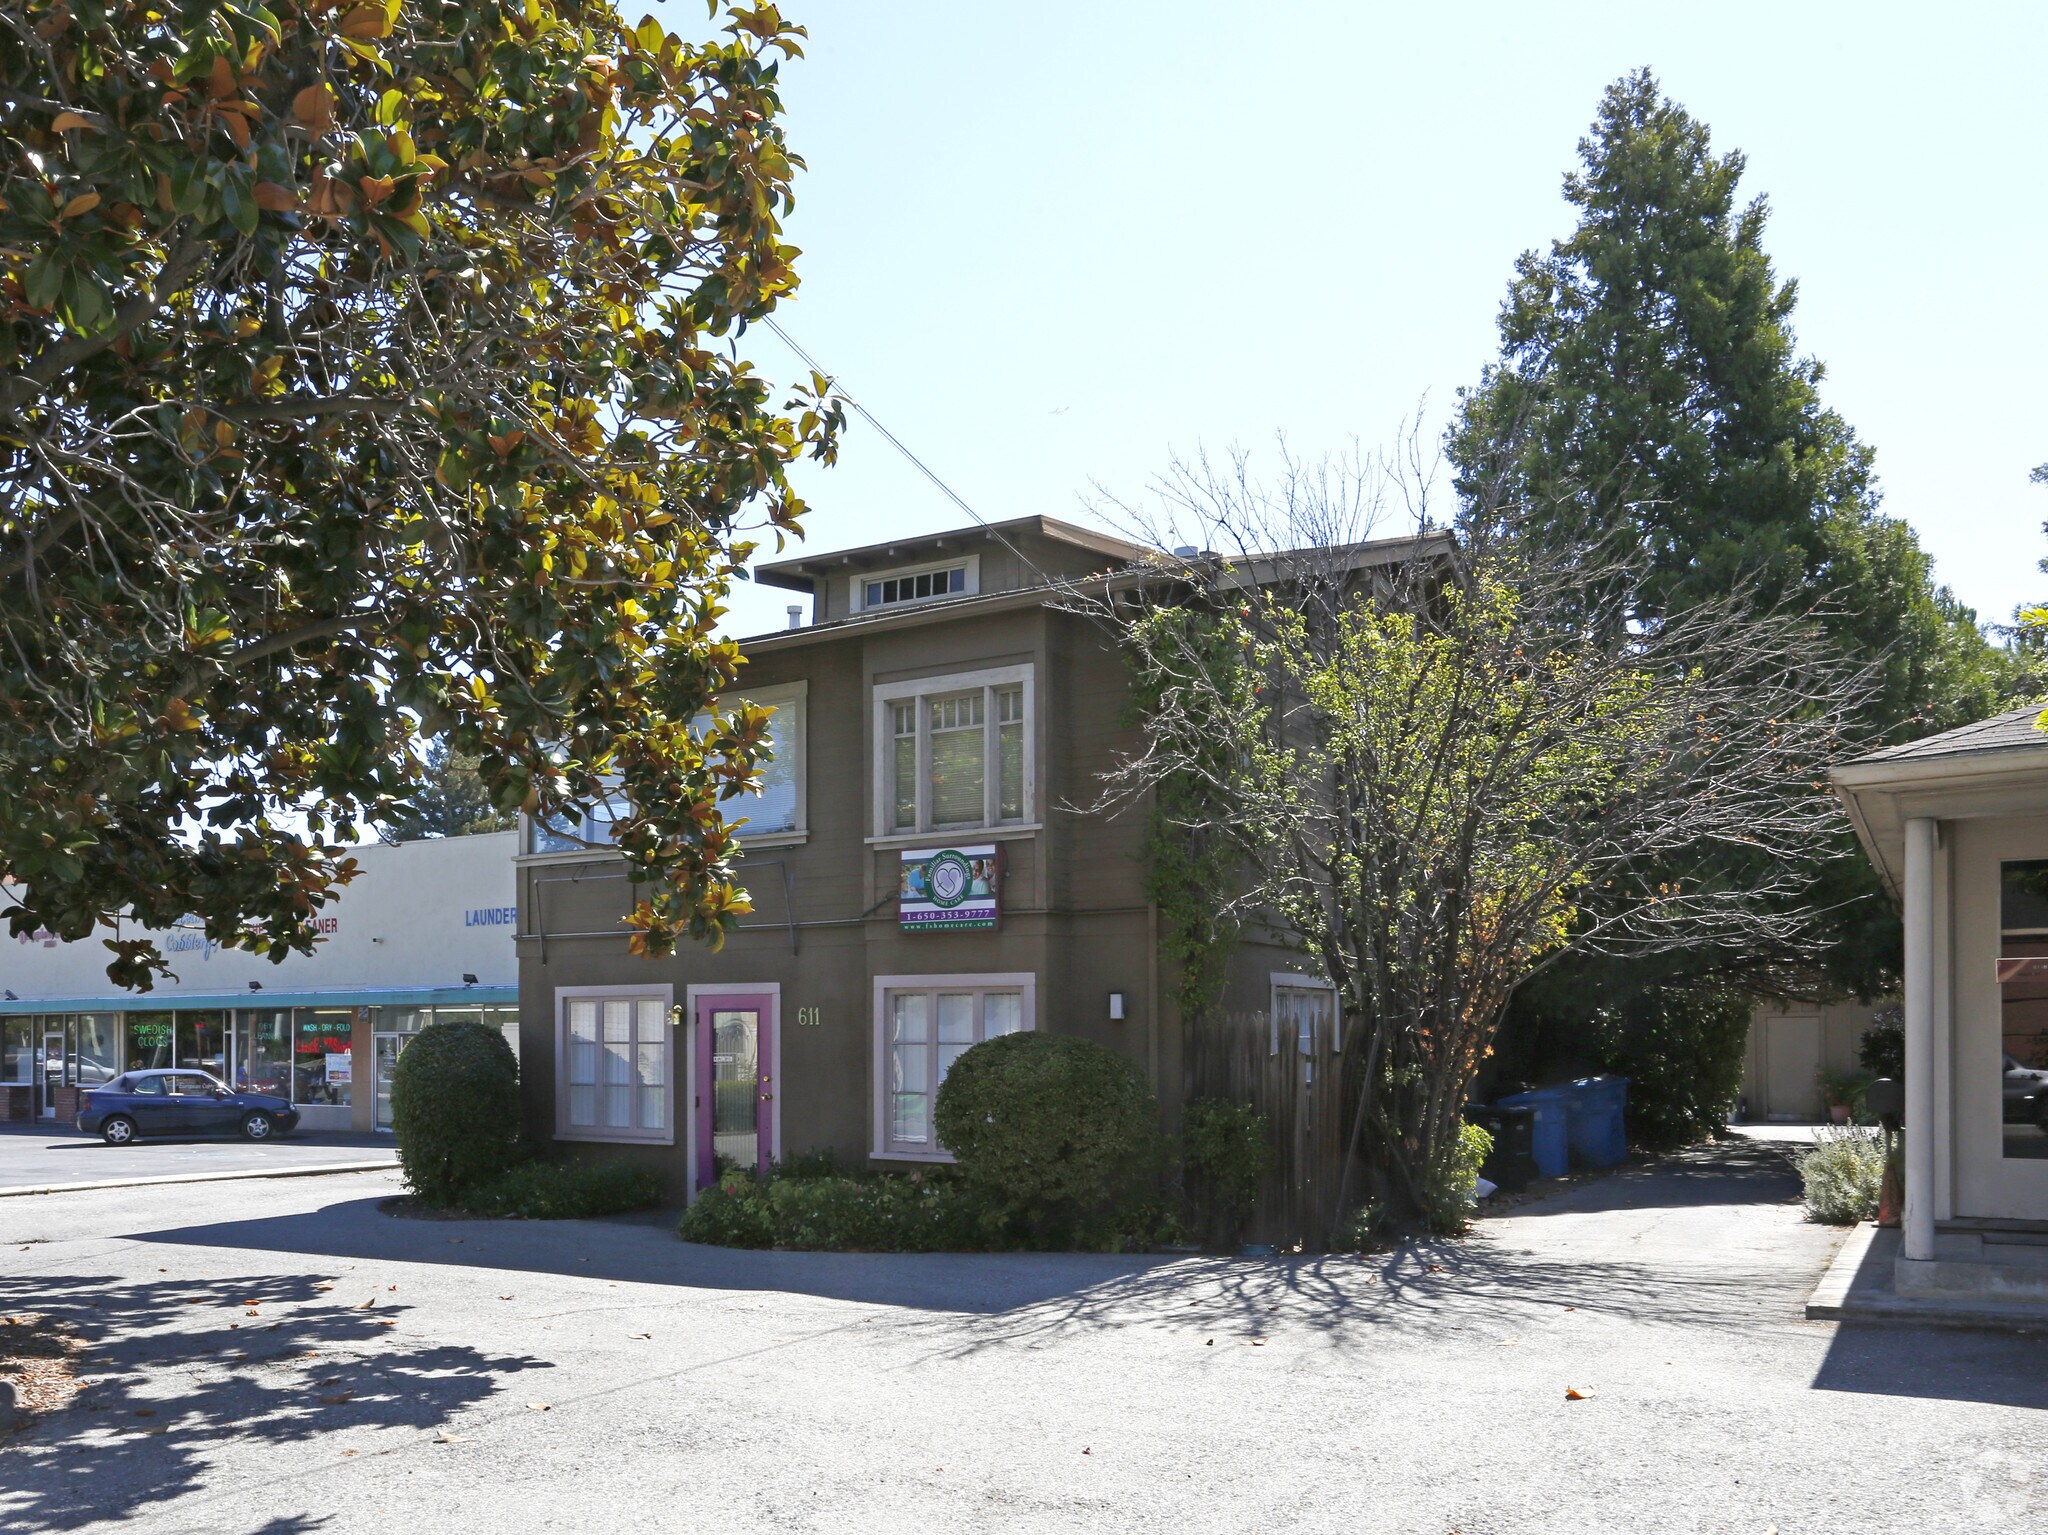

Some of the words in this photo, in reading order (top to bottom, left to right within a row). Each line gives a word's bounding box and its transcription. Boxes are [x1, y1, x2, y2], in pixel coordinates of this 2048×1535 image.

[925, 857, 942, 881] Familiar
[942, 853, 971, 880] Surroundings
[932, 896, 949, 906] HOME
[950, 895, 964, 906] CARE
[906, 909, 990, 921] 1-650-353-9777
[798, 1007, 820, 1026] 611
[133, 1024, 172, 1035] SWEDISH
[336, 1023, 351, 1032] FOLD
[137, 1036, 168, 1048] CLOGS
